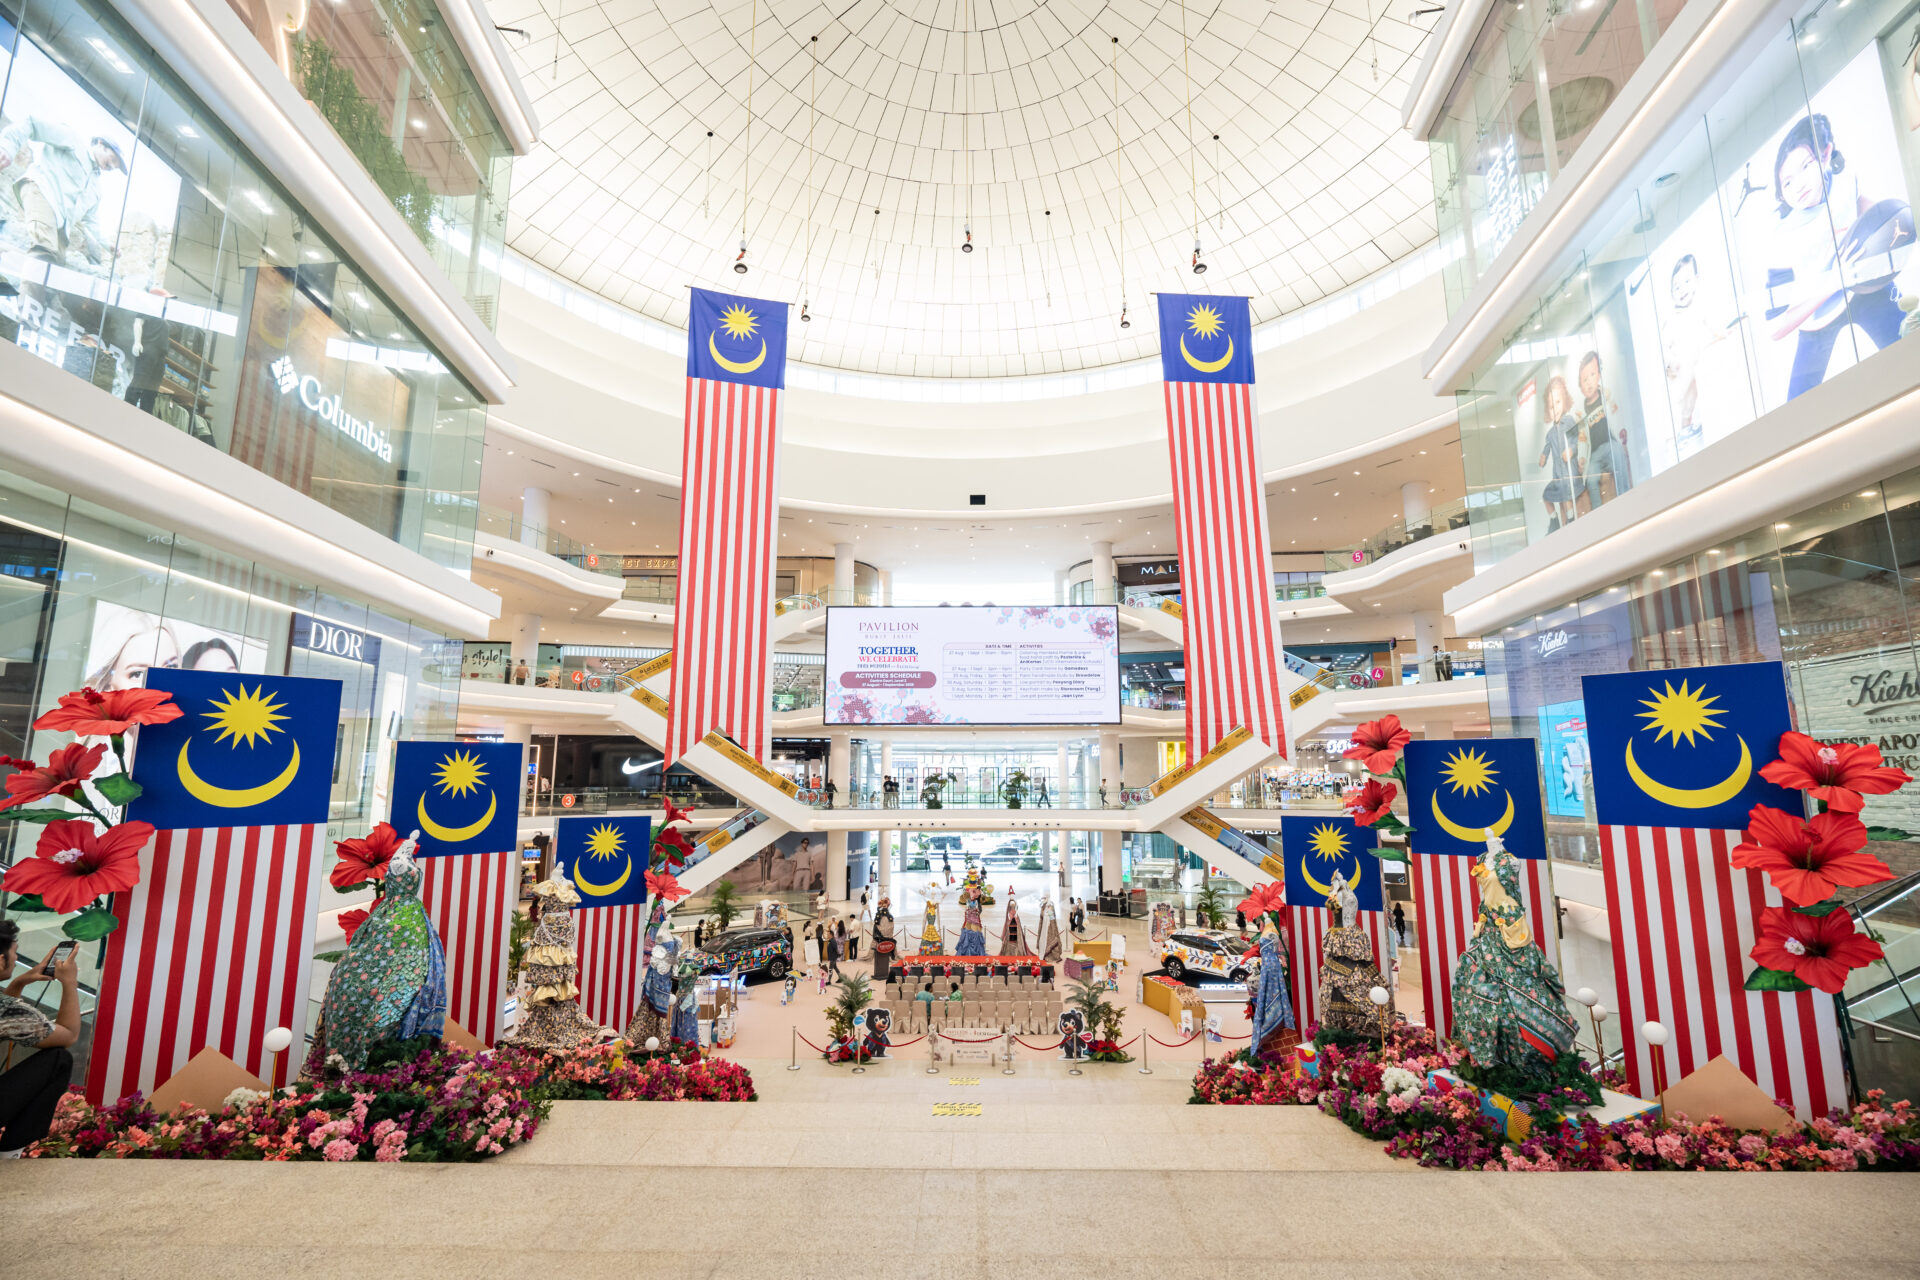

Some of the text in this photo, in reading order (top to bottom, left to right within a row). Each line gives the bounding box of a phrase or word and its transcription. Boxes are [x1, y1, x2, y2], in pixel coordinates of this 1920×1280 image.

[299, 374, 393, 463] Columbia
[590, 555, 596, 565] 5
[1354, 552, 1361, 561] 5
[859, 622, 919, 631] PAVILION
[309, 621, 362, 660] DIOR
[1537, 630, 1569, 655] Kiehl's
[858, 646, 919, 656] TOGETHER,
[471, 648, 503, 668] style!
[858, 655, 919, 663] WE CELEBRATE
[574, 672, 581, 681] 4
[1374, 669, 1381, 678] 4
[1868, 716, 1900, 724] SINCE
[565, 796, 572, 805] 3
